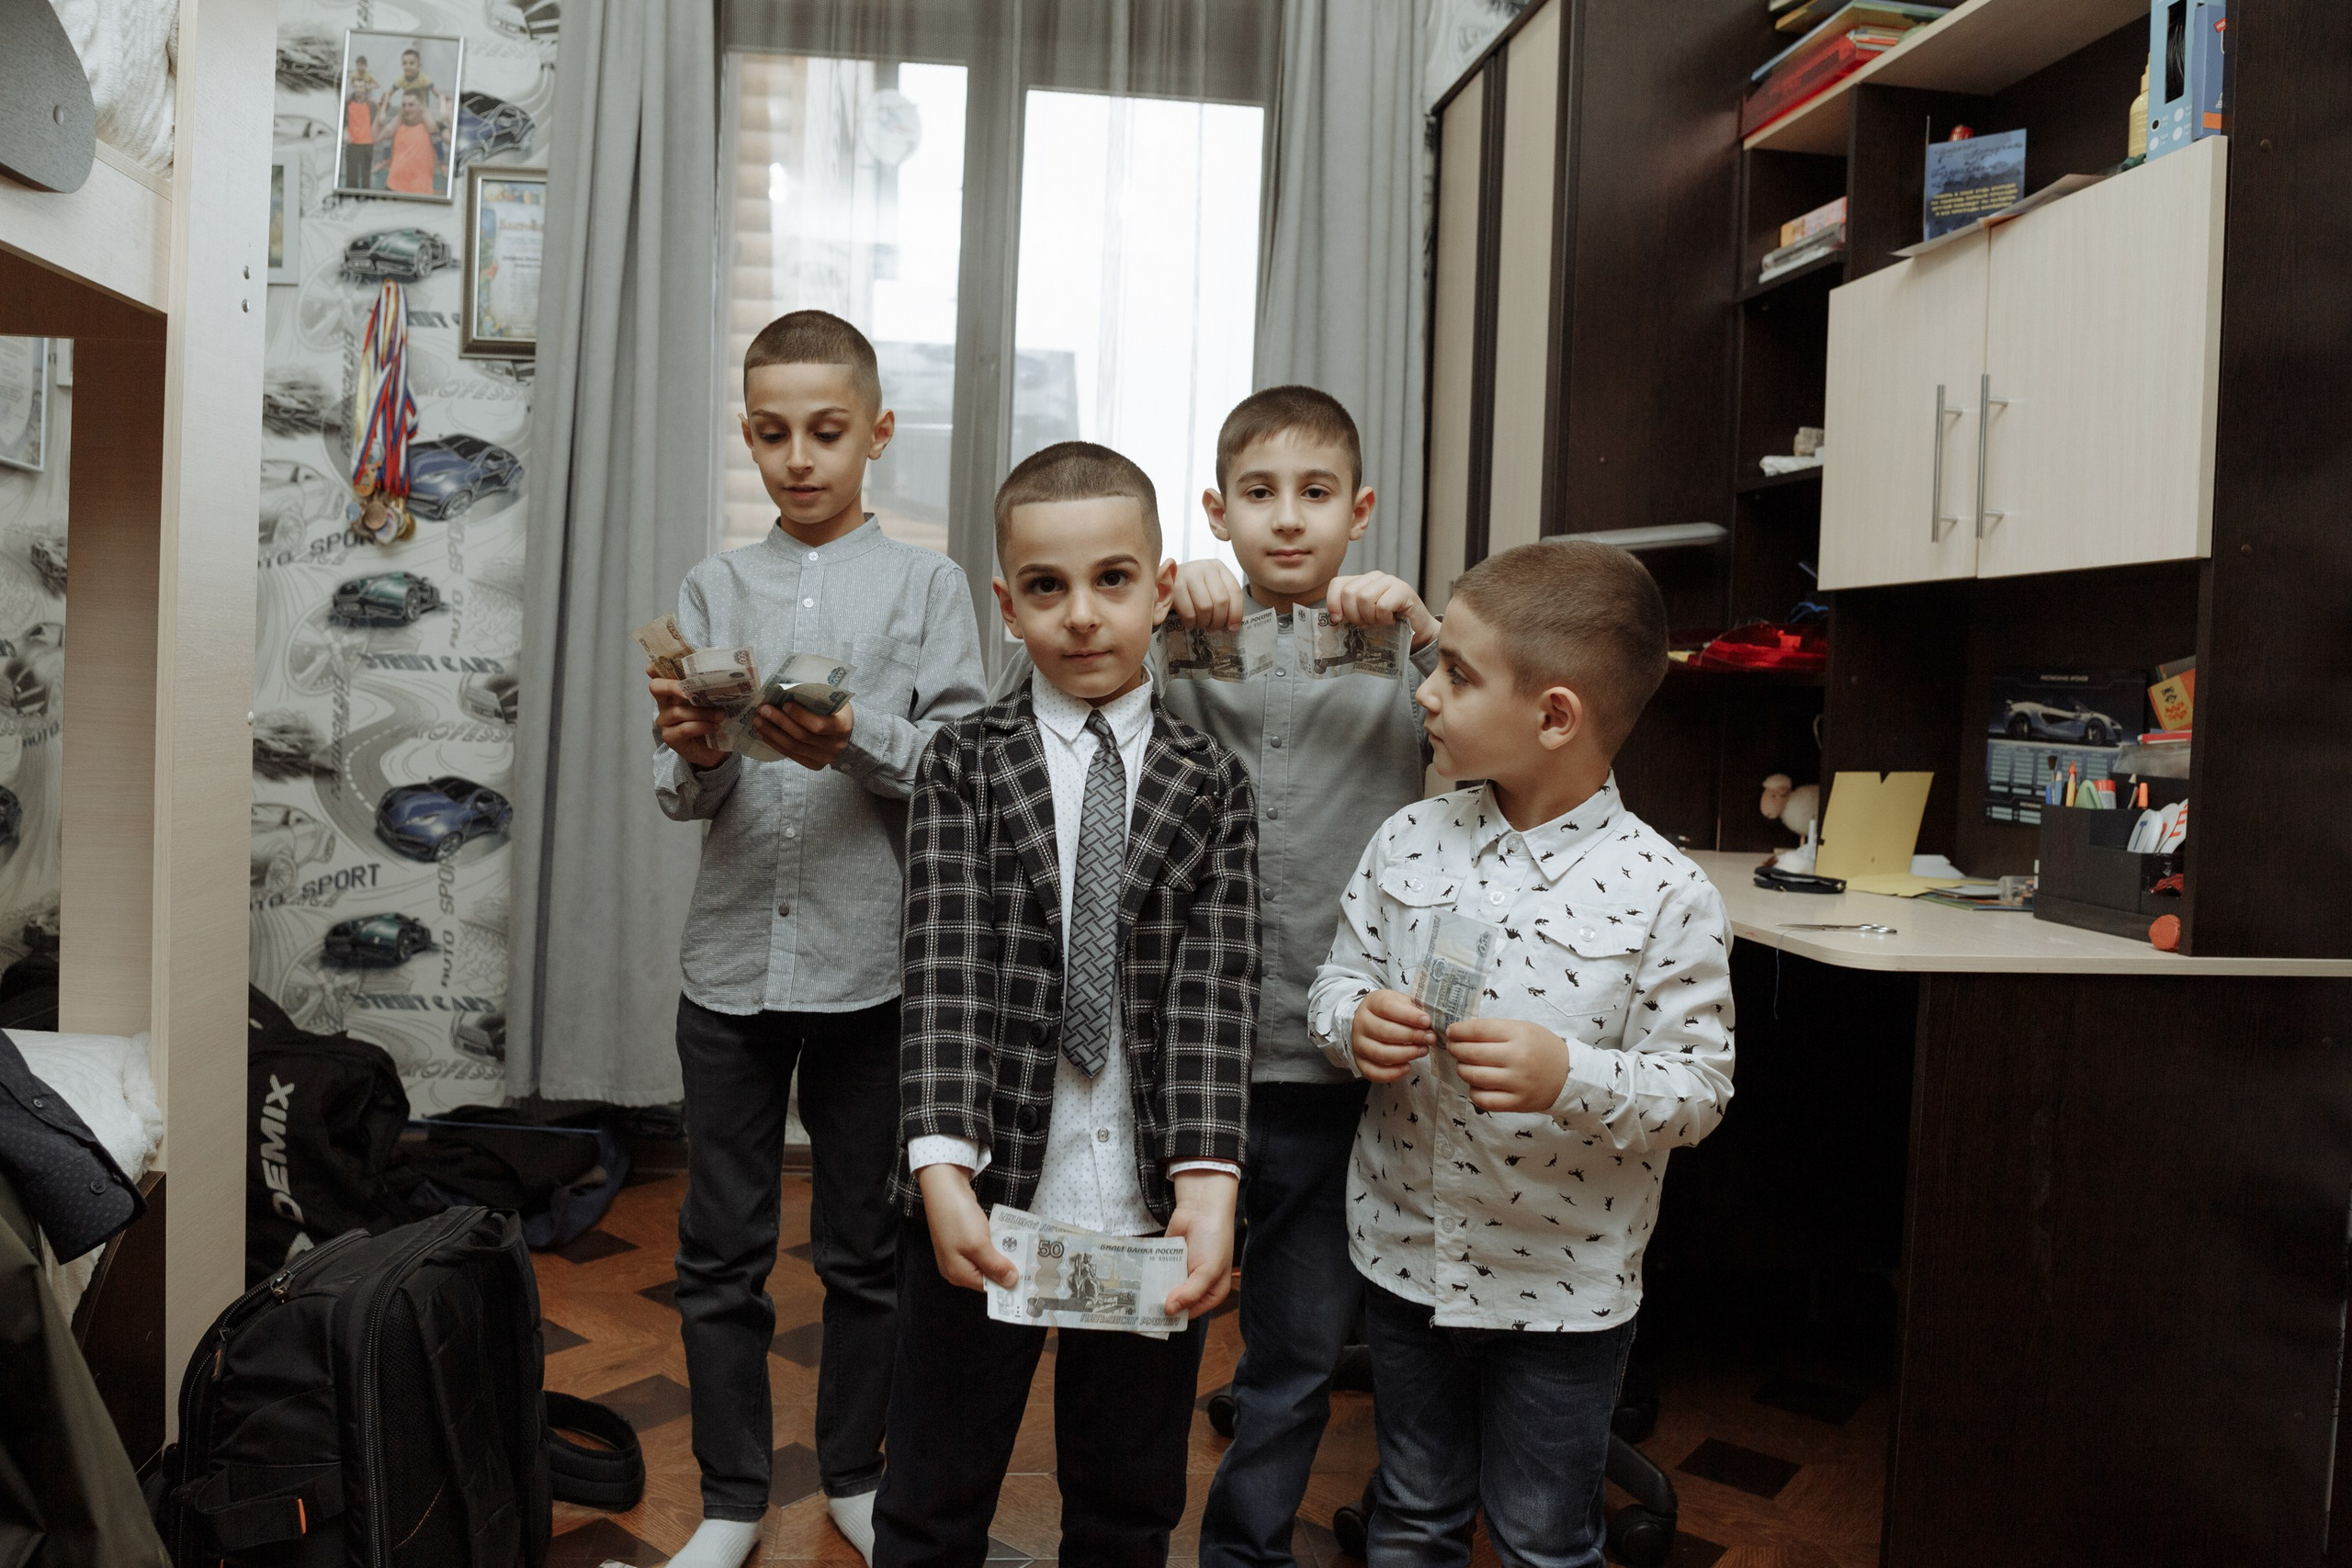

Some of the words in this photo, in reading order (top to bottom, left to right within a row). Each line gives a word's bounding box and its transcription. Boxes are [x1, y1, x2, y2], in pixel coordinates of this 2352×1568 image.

[301, 863, 381, 899] SPORT
[260, 1073, 305, 1224] DEMIX
[1037, 1240, 1065, 1258] 50
[1100, 1244, 1126, 1253] БИЛЕТ
[1126, 1246, 1153, 1255] БАНКА
